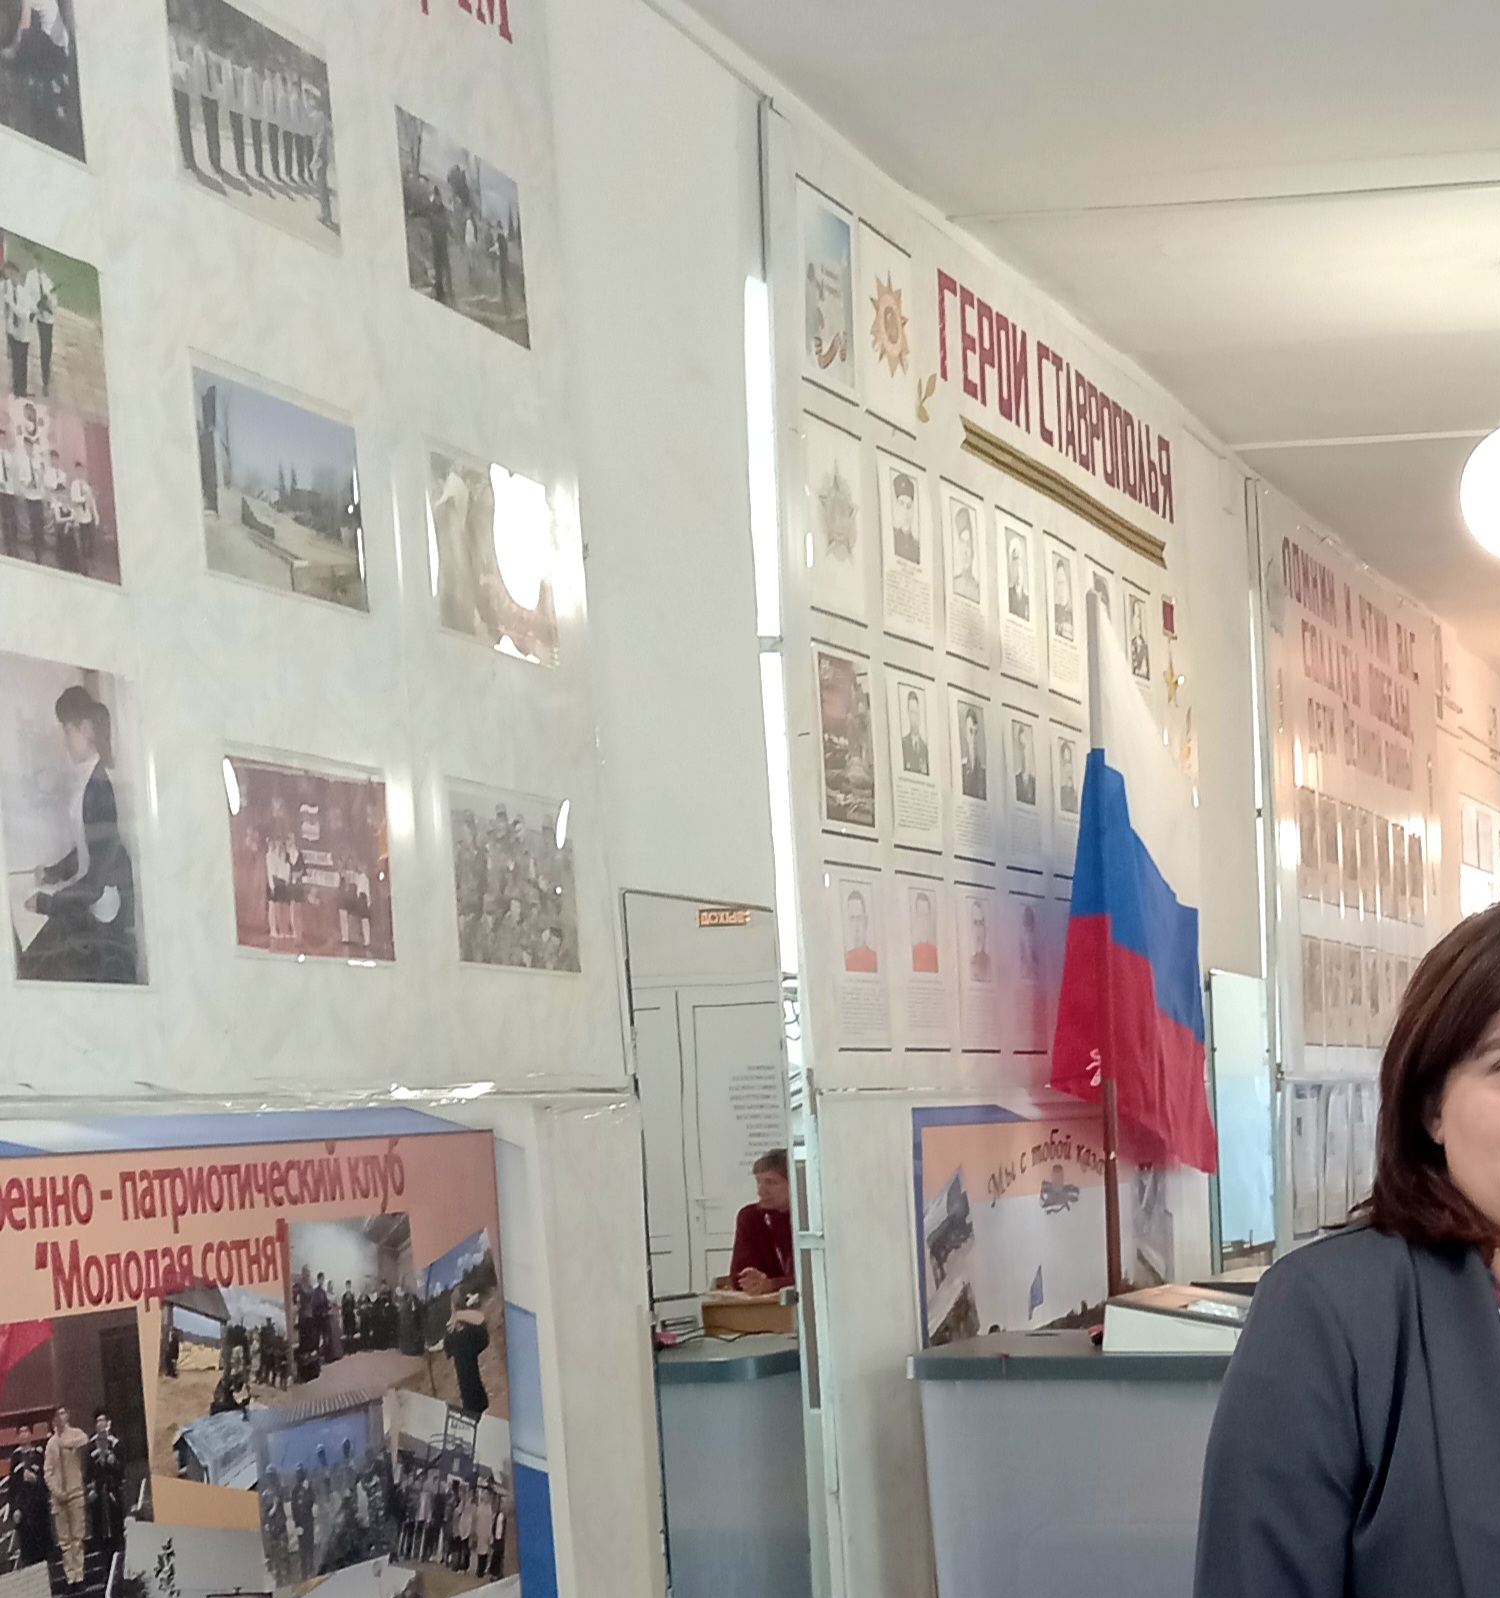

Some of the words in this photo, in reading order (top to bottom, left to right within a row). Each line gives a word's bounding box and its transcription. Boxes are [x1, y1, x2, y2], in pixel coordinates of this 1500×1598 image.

[937, 268, 1030, 434] ГЕРОИ
[1037, 340, 1174, 524] СТАВРОПОЛЬЯ
[0, 1173, 93, 1231] енно
[119, 1141, 344, 1234] патриотический
[348, 1138, 406, 1213] клуб
